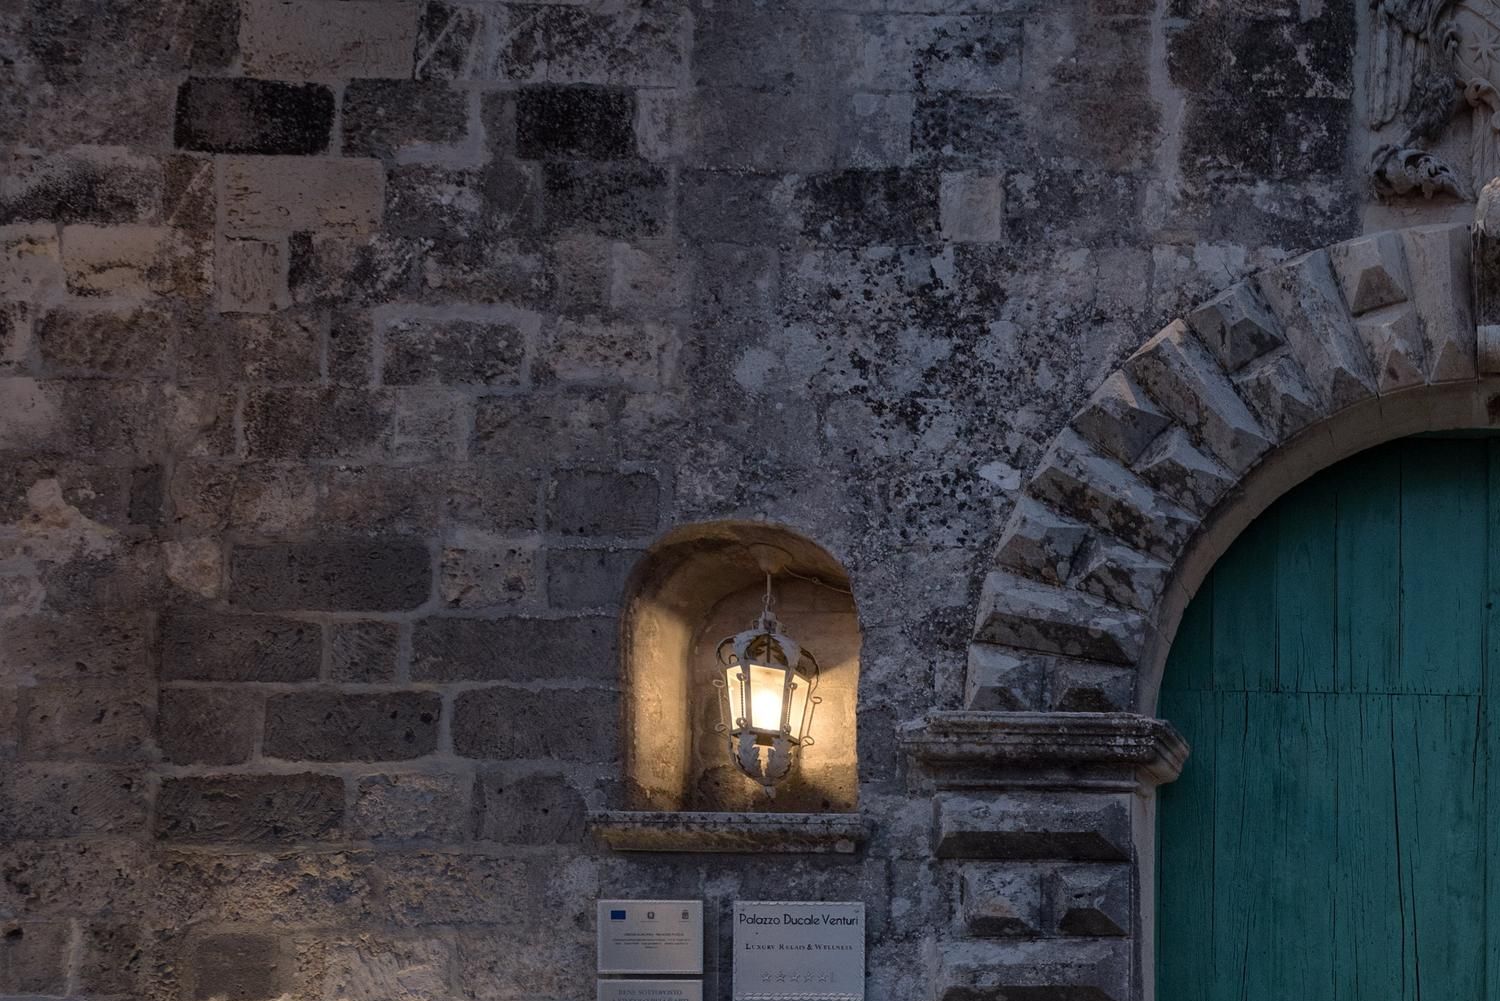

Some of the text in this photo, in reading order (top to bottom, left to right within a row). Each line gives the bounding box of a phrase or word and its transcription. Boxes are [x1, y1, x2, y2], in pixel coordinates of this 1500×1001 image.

[739, 913, 859, 926] Palazzo Ducale Venturi
[806, 943, 813, 951] &
